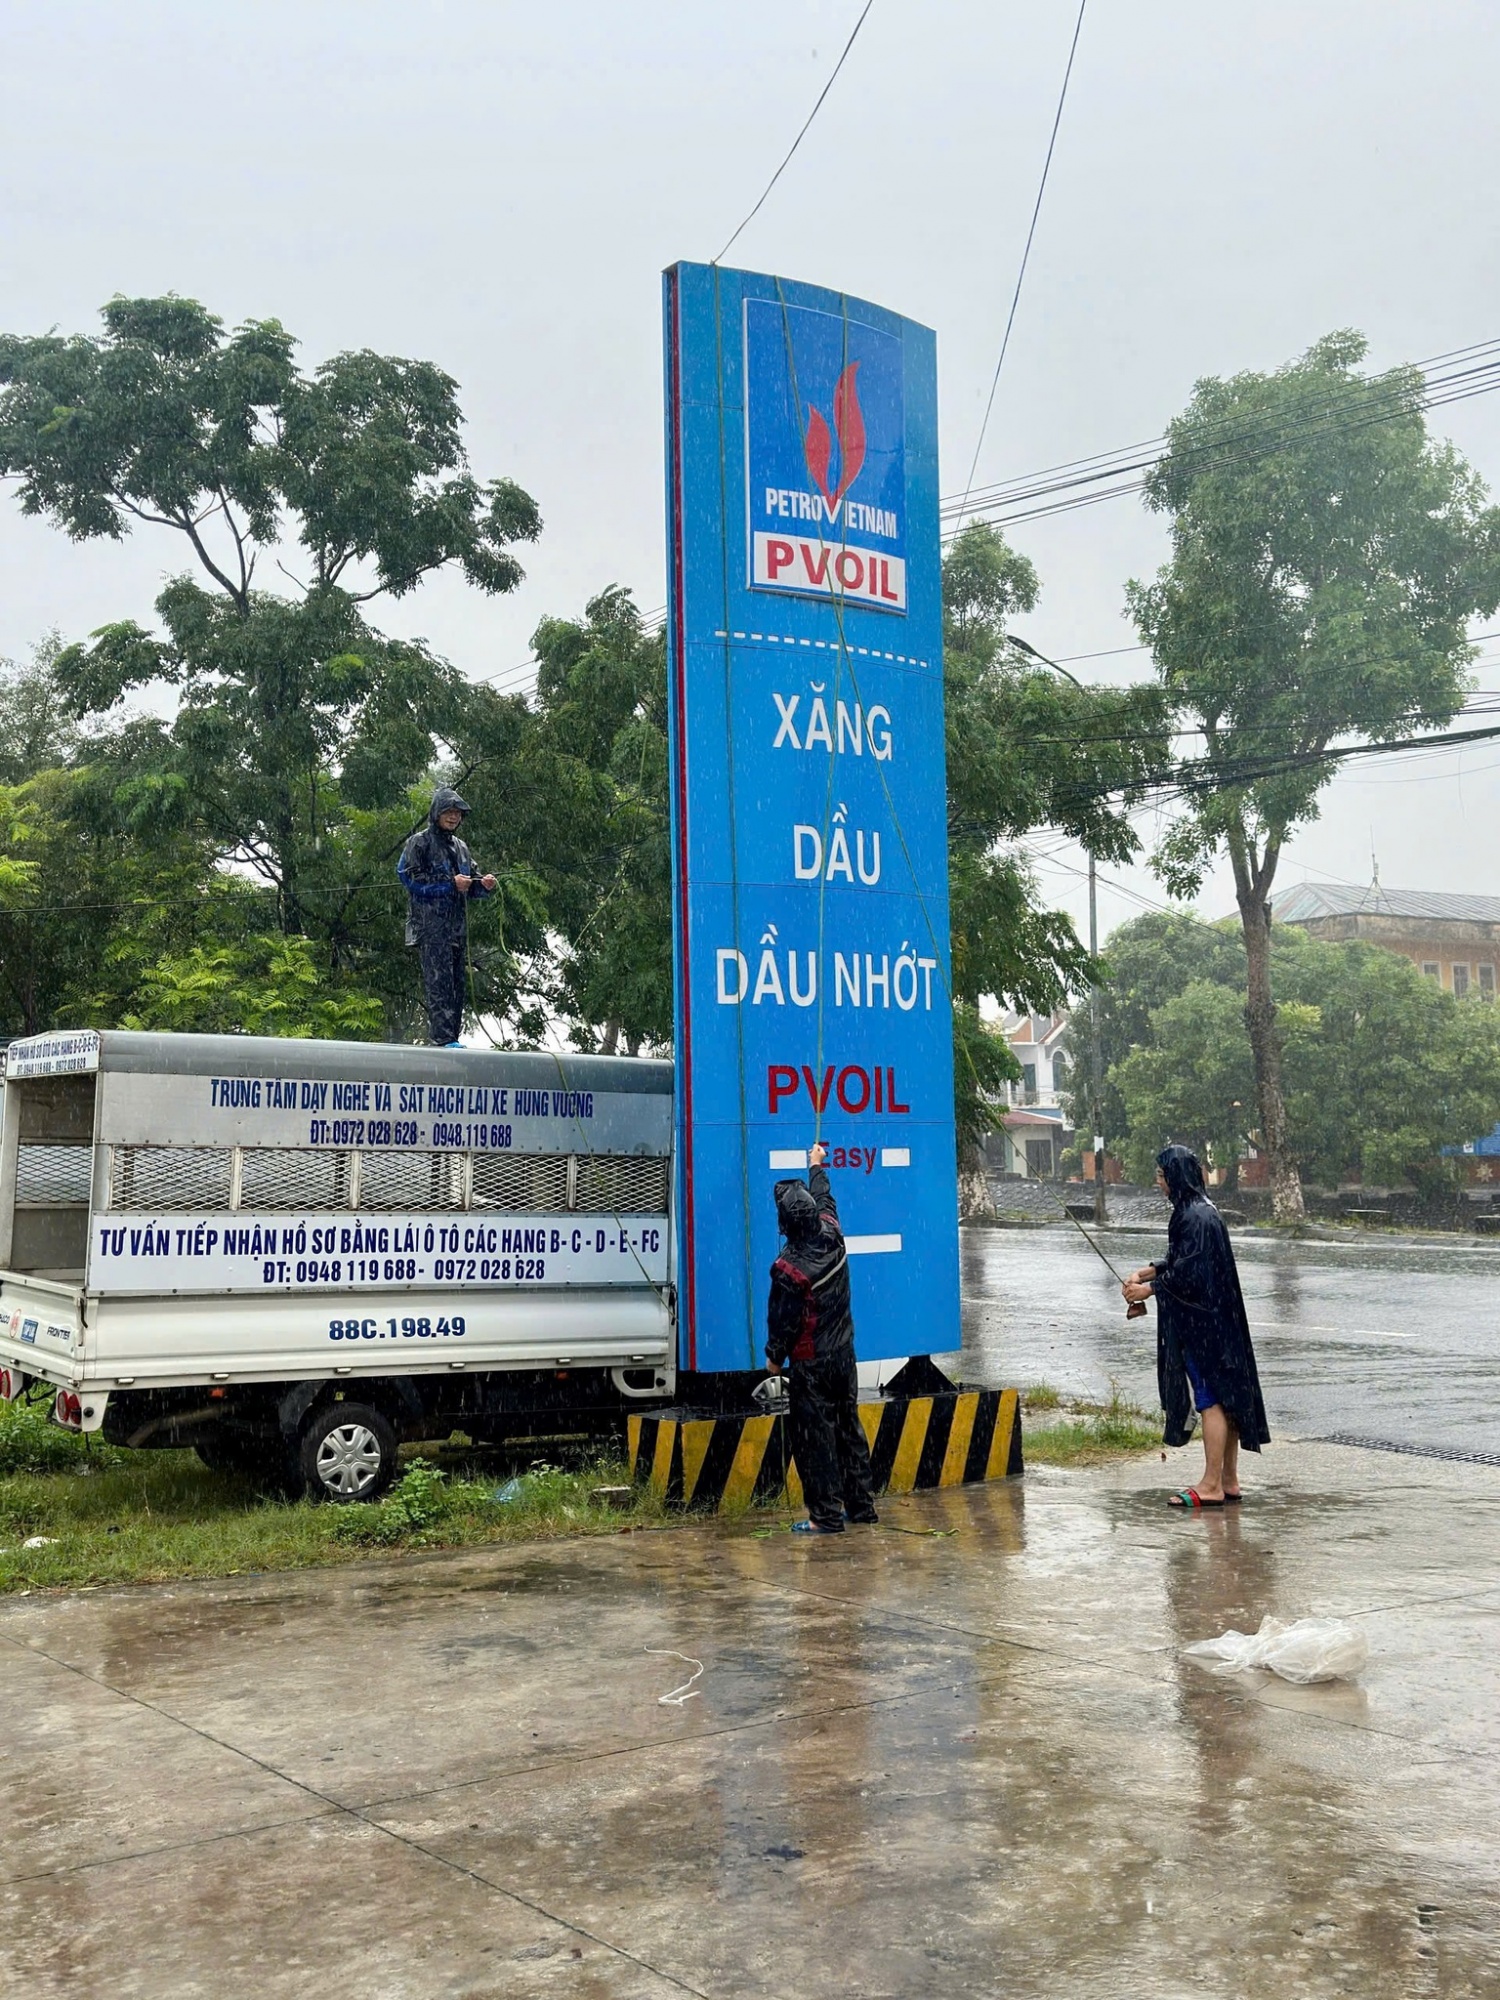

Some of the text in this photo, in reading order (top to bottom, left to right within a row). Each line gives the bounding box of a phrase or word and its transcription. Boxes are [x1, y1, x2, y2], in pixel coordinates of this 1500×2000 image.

[765, 487, 897, 539] PETROVIETNAM
[766, 539, 898, 601] PVOIL
[772, 680, 893, 761] XĂNG
[793, 802, 882, 886] DẦU
[716, 924, 937, 1011] DẦU NHỚT
[211, 1079, 261, 1108] TRUNG
[265, 1077, 297, 1109] TÂM
[301, 1082, 328, 1114] DẠY
[428, 1087, 464, 1118] HẠCH
[491, 1089, 508, 1115] XE
[767, 1065, 910, 1114] PVOIL
[310, 1120, 330, 1144] ĐT:
[333, 1121, 364, 1145] 0972
[368, 1121, 391, 1145] 028
[490, 1125, 513, 1148] 688
[814, 1141, 876, 1174] Easy
[100, 1227, 127, 1257] TƯ
[130, 1220, 170, 1256] VẤN
[176, 1221, 218, 1256] TIẾP
[223, 1223, 277, 1261] NHẬN
[282, 1220, 307, 1255] HỒ
[311, 1227, 337, 1254] SƠ
[340, 1219, 389, 1254] BẰNG
[394, 1223, 419, 1253] LÁI
[424, 1223, 435, 1253] Ô
[439, 1223, 460, 1253] TÔ
[464, 1224, 497, 1254] CÁC
[501, 1229, 546, 1258] HẠNG
[571, 1229, 582, 1253] C
[596, 1229, 606, 1253] D
[619, 1229, 628, 1253] E
[642, 1229, 660, 1253] FC
[263, 1261, 291, 1283] ĐT:
[296, 1260, 342, 1283] 0948
[347, 1260, 379, 1281] 119
[434, 1259, 476, 1280] 0972
[480, 1259, 511, 1280] 028
[515, 1259, 545, 1280] 628
[329, 1316, 466, 1341] 88C.198.49
